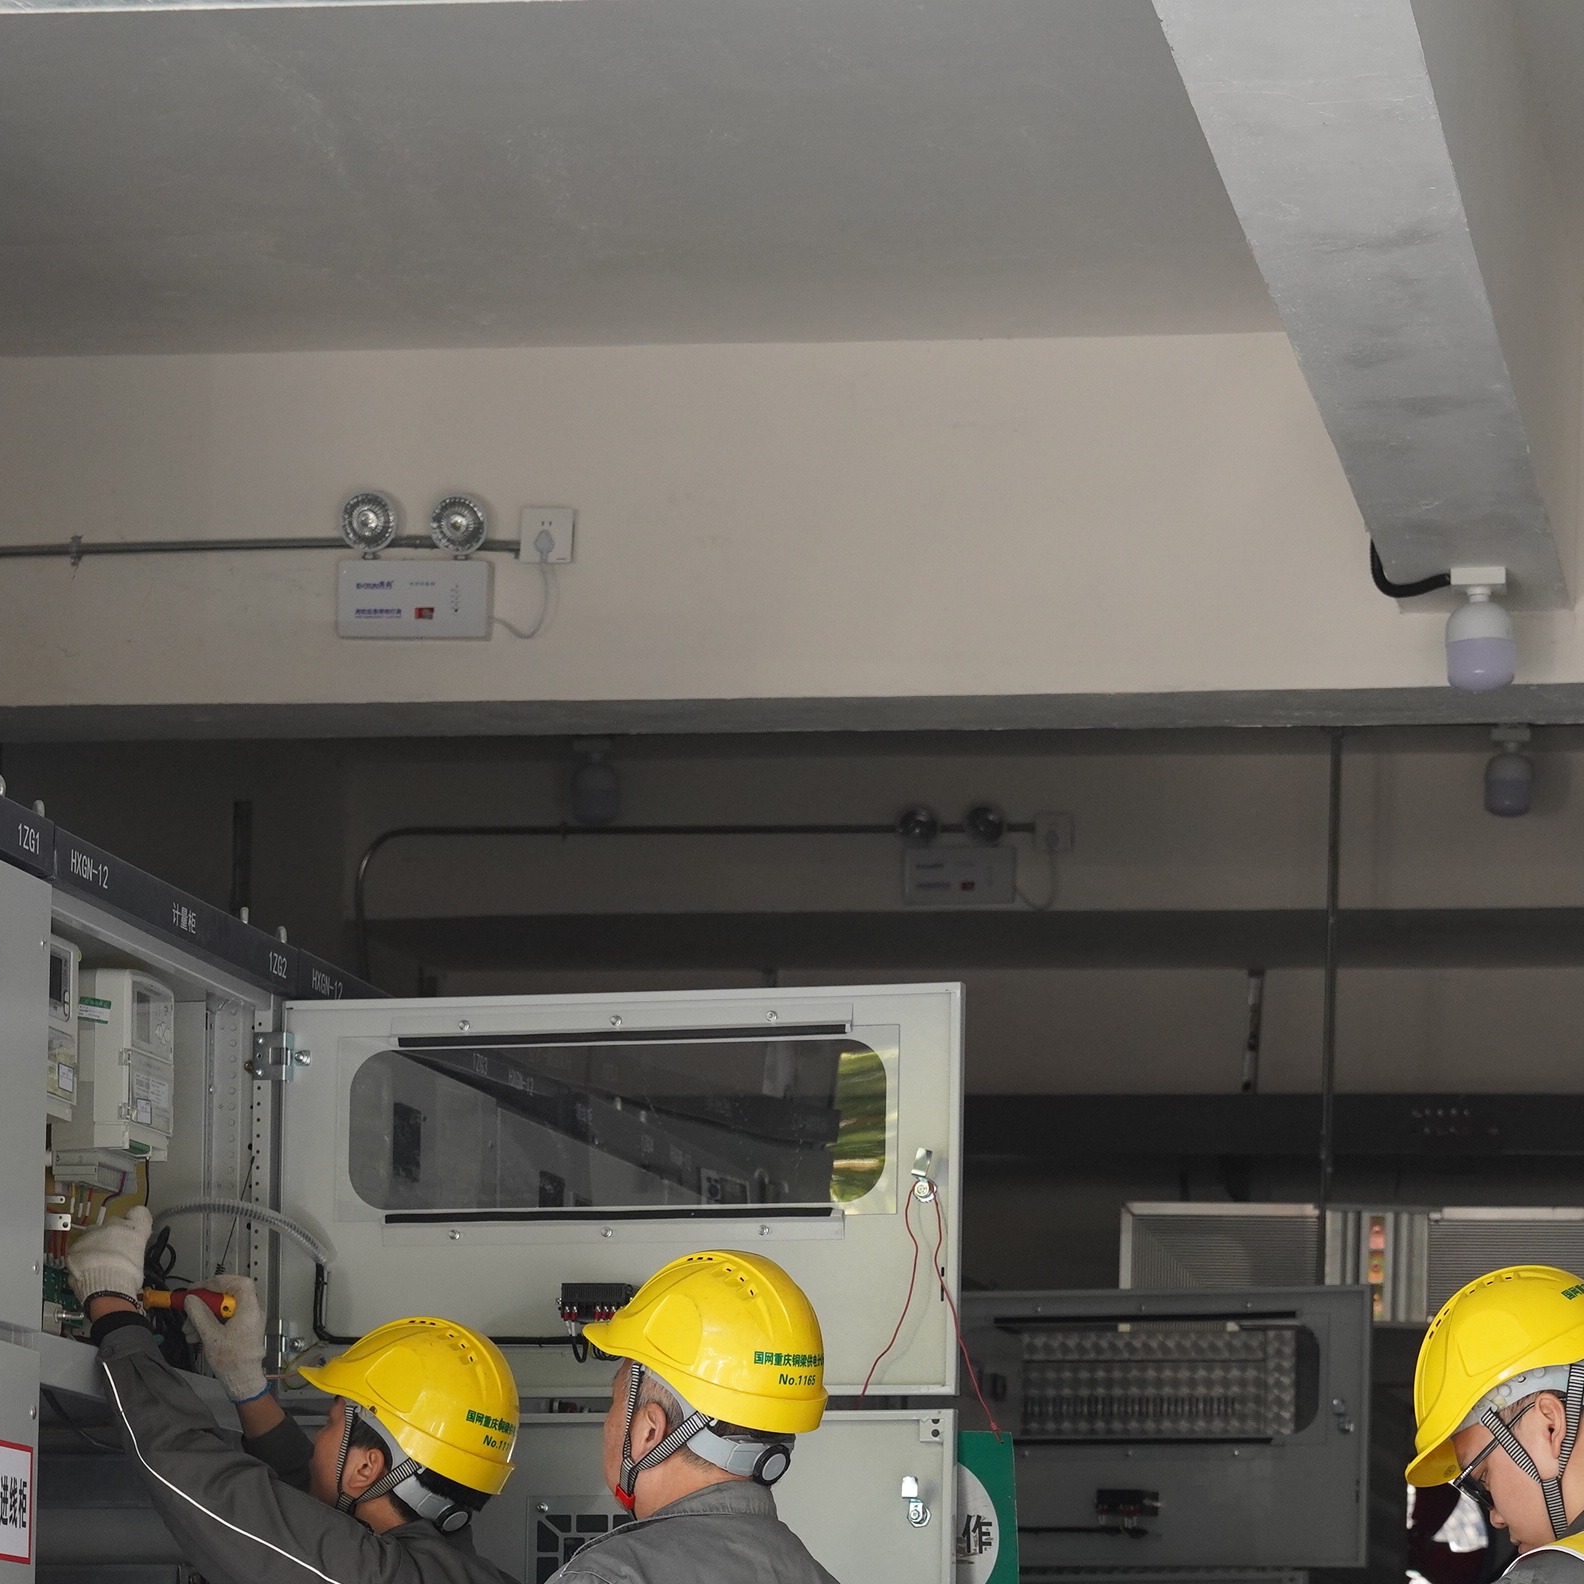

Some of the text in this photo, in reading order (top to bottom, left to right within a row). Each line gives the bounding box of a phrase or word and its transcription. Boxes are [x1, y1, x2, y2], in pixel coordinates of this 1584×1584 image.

[17, 822, 40, 855] 1ZG1
[70, 849, 109, 890] HXGN-12
[172, 901, 197, 934] 计量柜
[268, 951, 288, 980] 1ZG2
[779, 1374, 816, 1386] No.1165
[962, 1514, 993, 1554] 作
